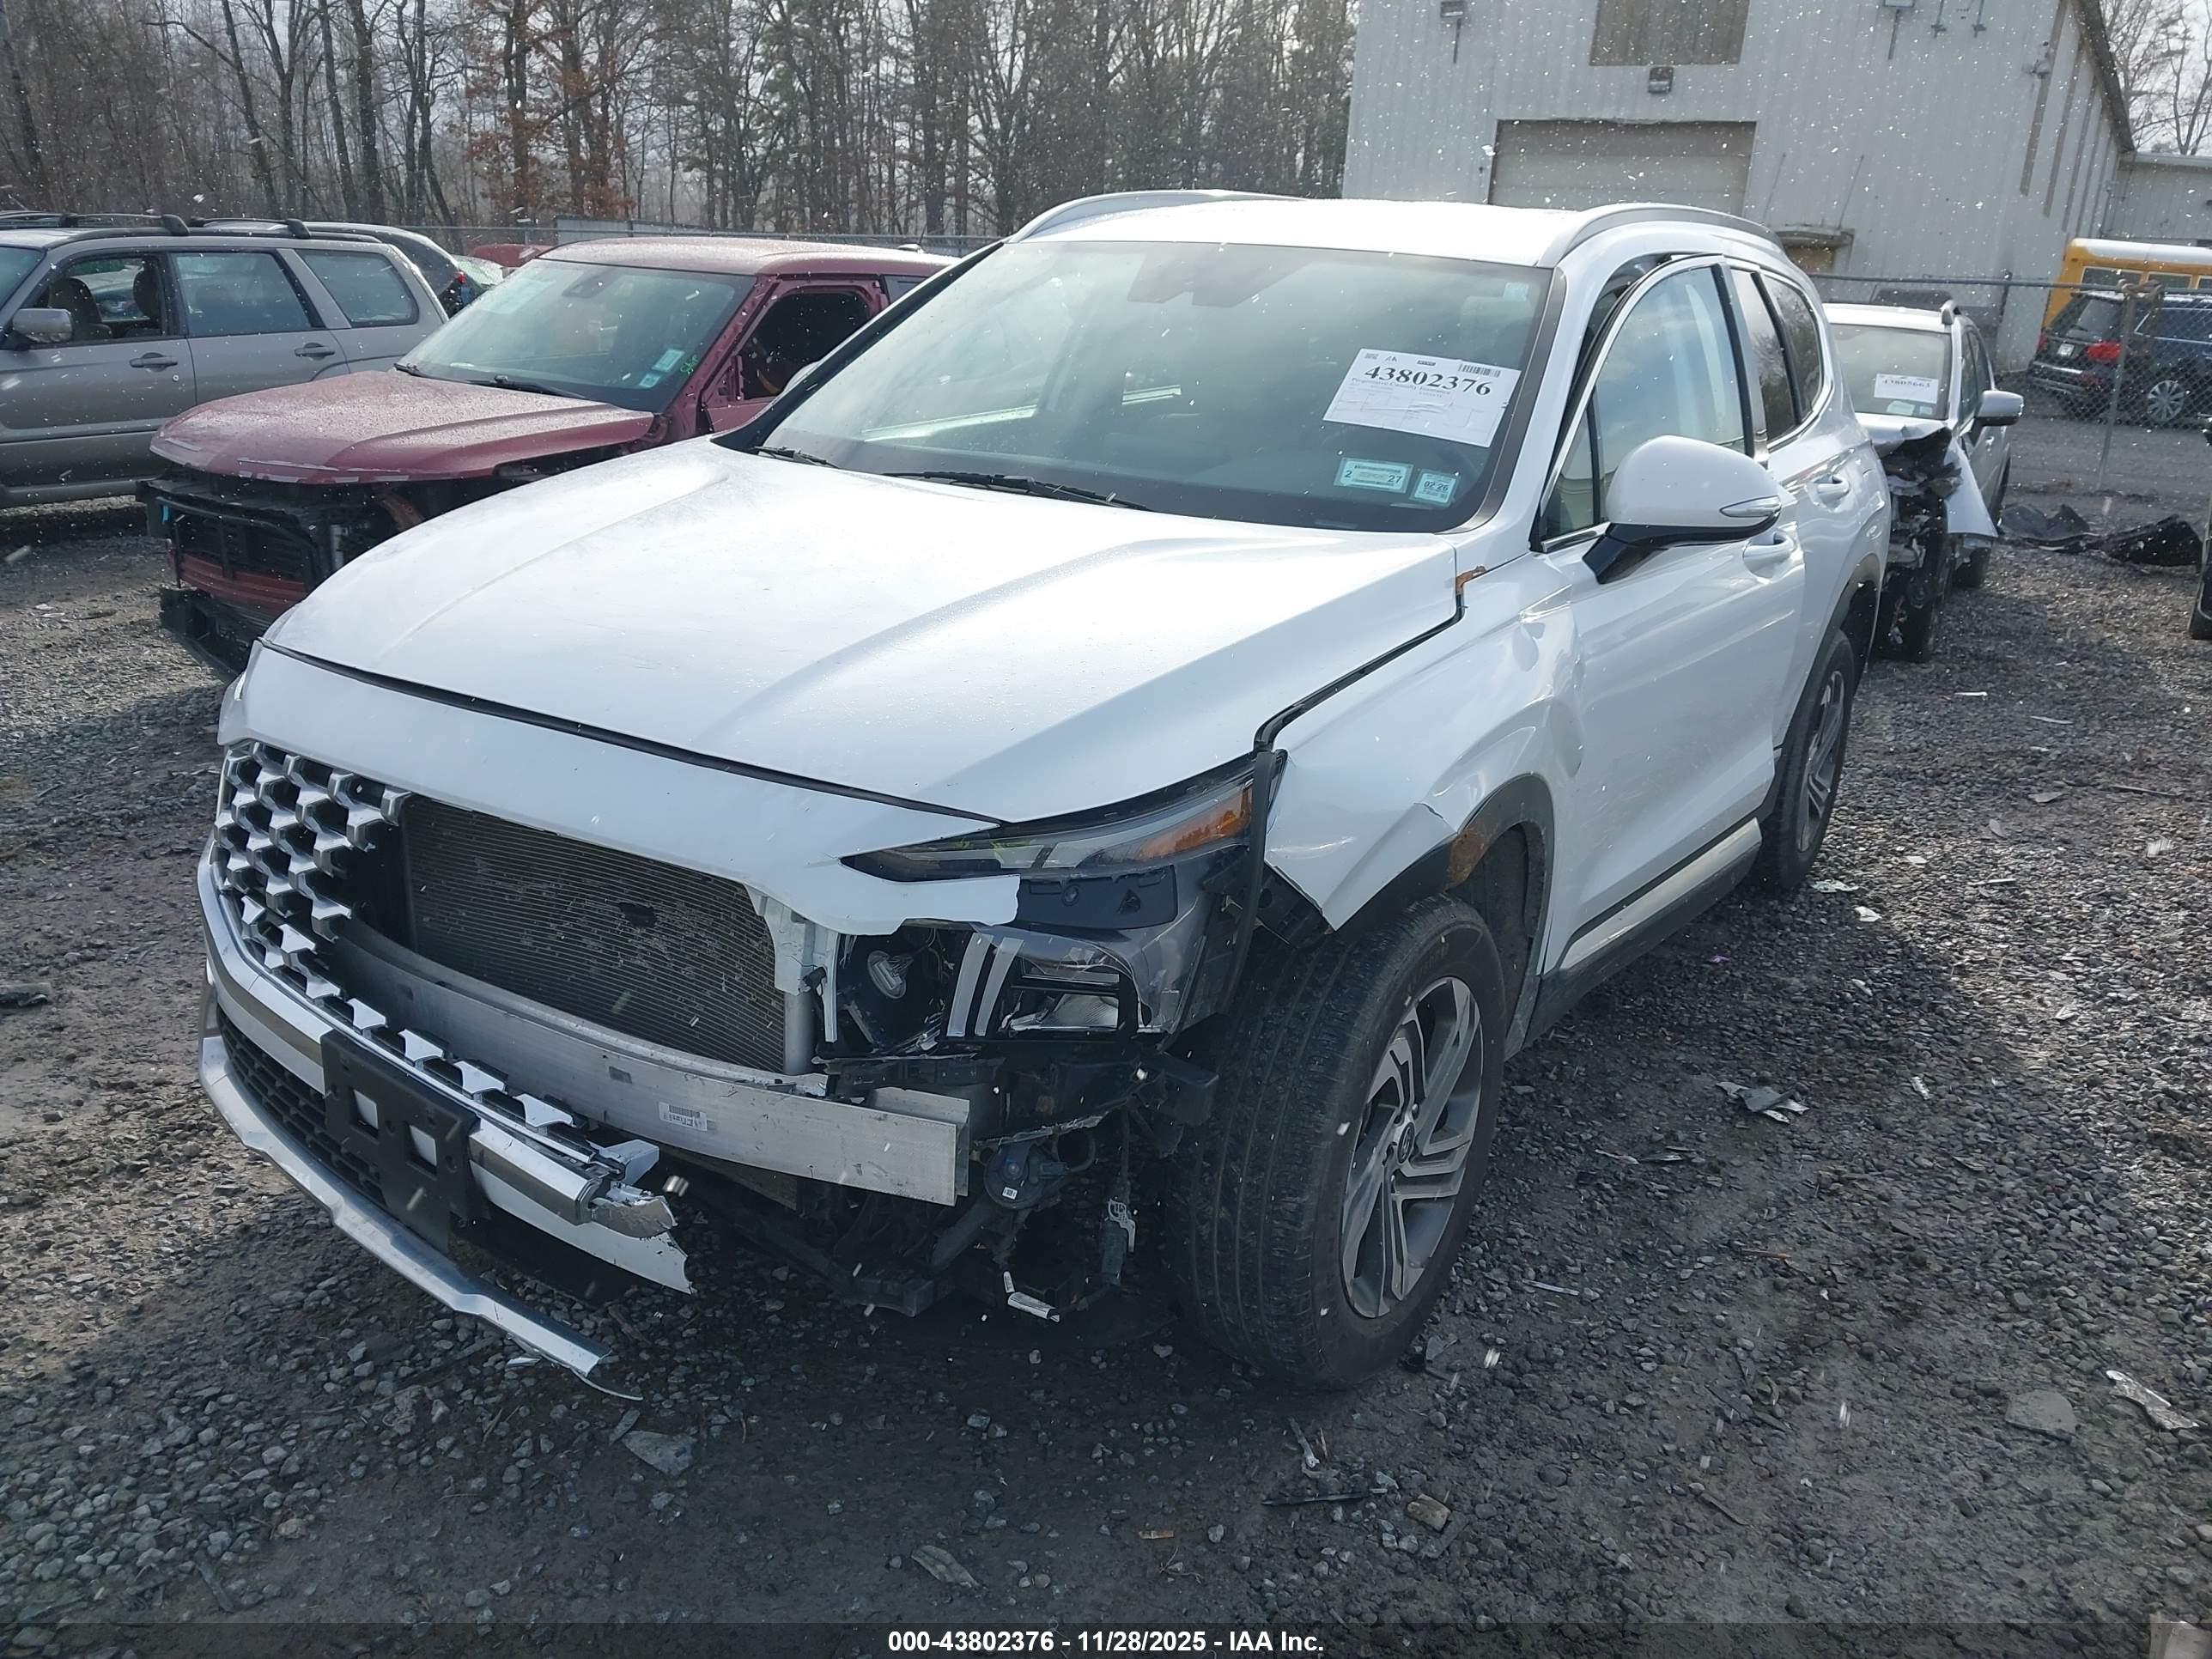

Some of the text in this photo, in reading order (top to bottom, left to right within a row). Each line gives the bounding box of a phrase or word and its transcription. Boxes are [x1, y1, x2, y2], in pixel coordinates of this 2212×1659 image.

[1364, 365, 1492, 396] 43802376
[1344, 470, 1352, 479] 2
[1388, 475, 1402, 484] 27
